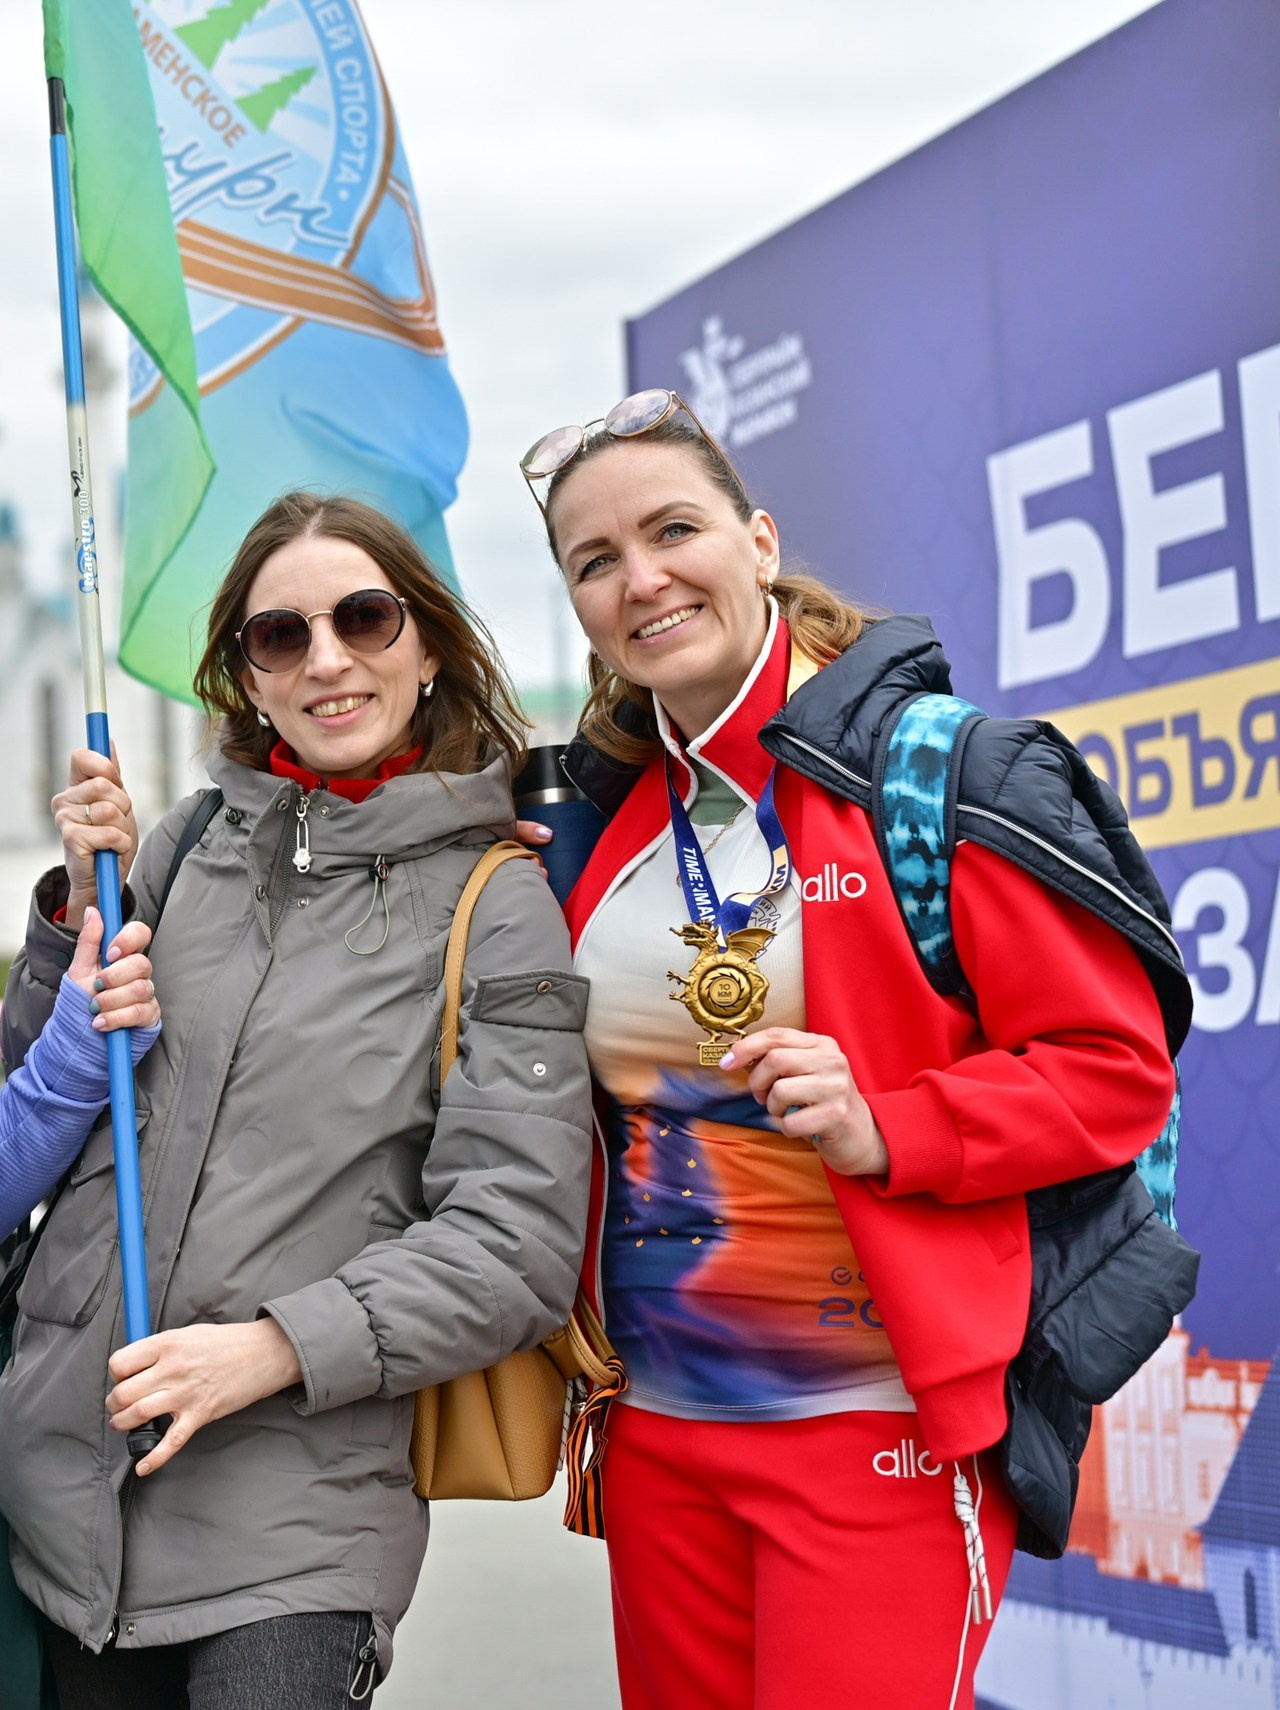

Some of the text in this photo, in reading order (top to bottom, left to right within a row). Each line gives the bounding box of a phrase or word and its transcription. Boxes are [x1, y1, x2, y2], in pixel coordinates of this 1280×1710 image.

[133, 7, 247, 149] МЕНСКОЕ
[311, 0, 370, 184] ЕЙ СПОРТА
[78, 490, 96, 588] Maestro 300
[802, 862, 867, 902] allo
[719, 983, 731, 991] 10
